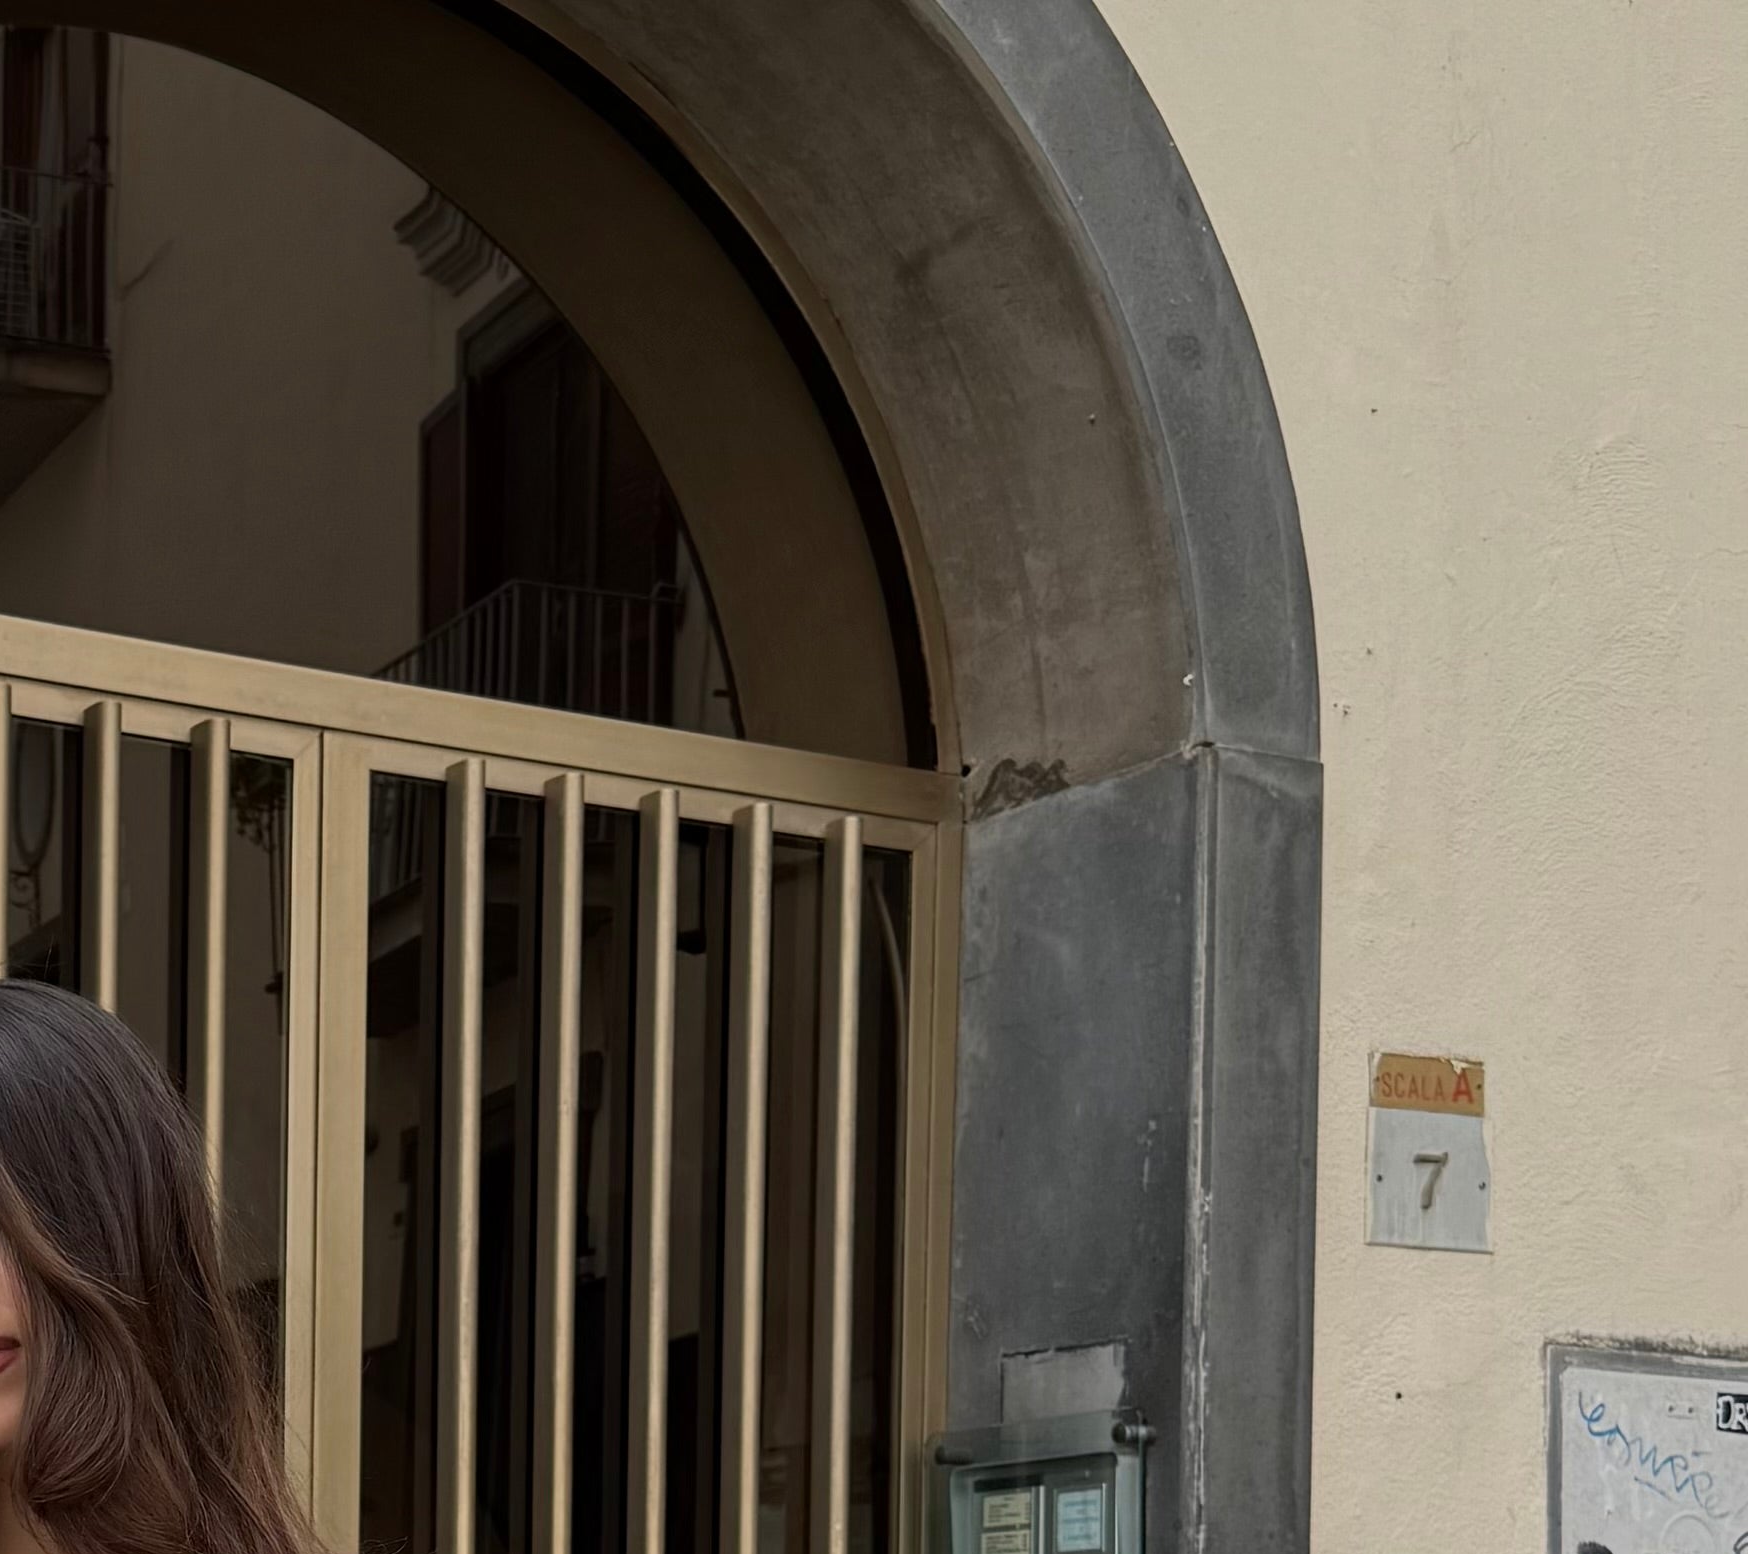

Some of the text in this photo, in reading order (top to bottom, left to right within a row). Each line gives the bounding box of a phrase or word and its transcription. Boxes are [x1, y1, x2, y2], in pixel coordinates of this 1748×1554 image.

[1381, 1070, 1475, 1104] SCALA A
[1412, 1151, 1449, 1210] 7
